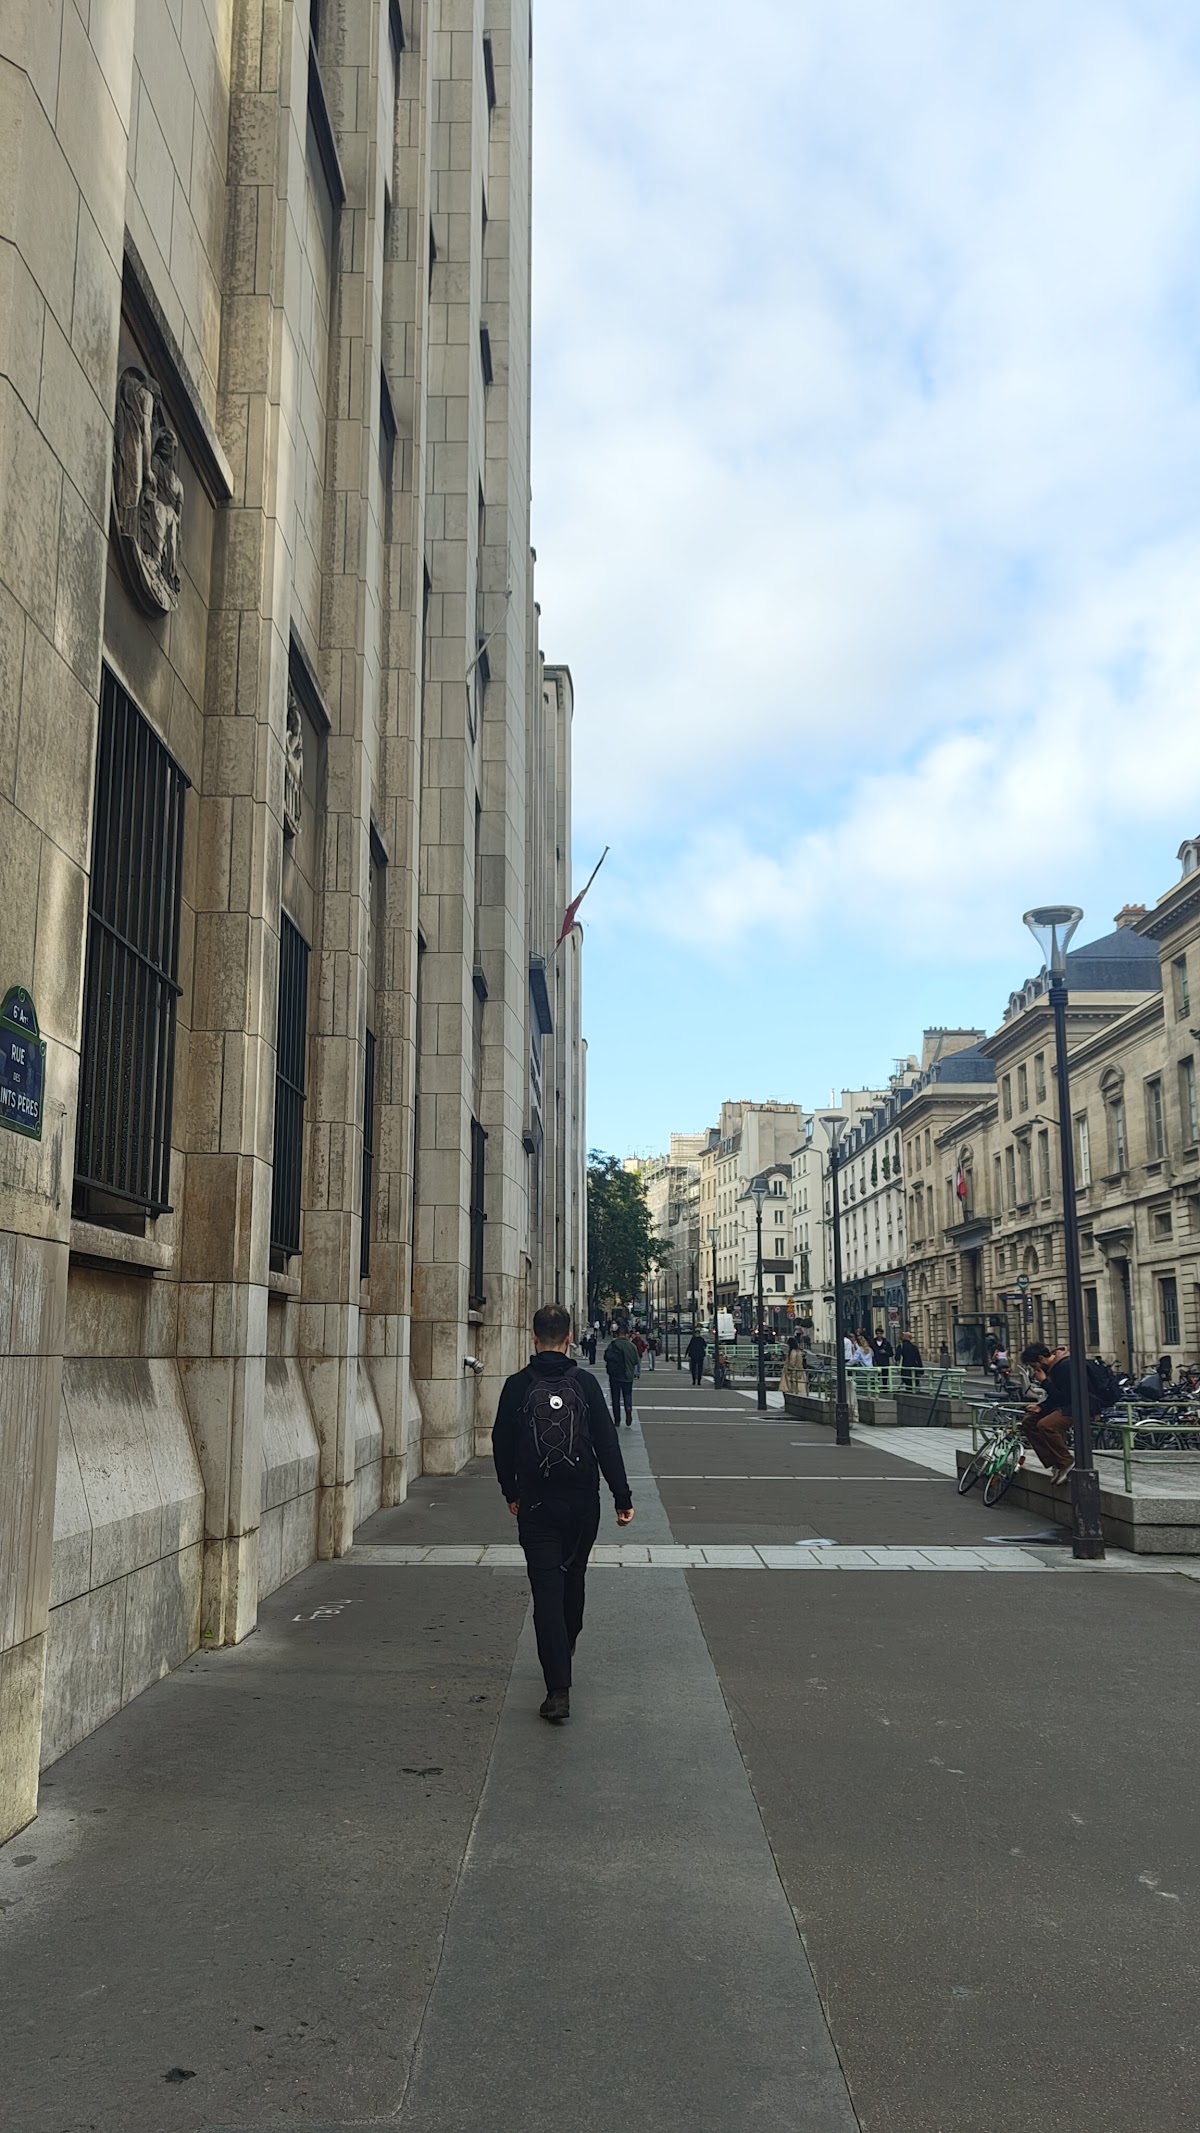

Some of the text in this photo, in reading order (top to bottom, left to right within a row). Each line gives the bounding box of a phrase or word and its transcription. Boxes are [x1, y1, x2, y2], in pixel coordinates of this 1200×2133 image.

[11, 1043, 26, 1066] RUE
[13, 1071, 21, 1083] DES
[17, 1092, 38, 1117] PÈRES
